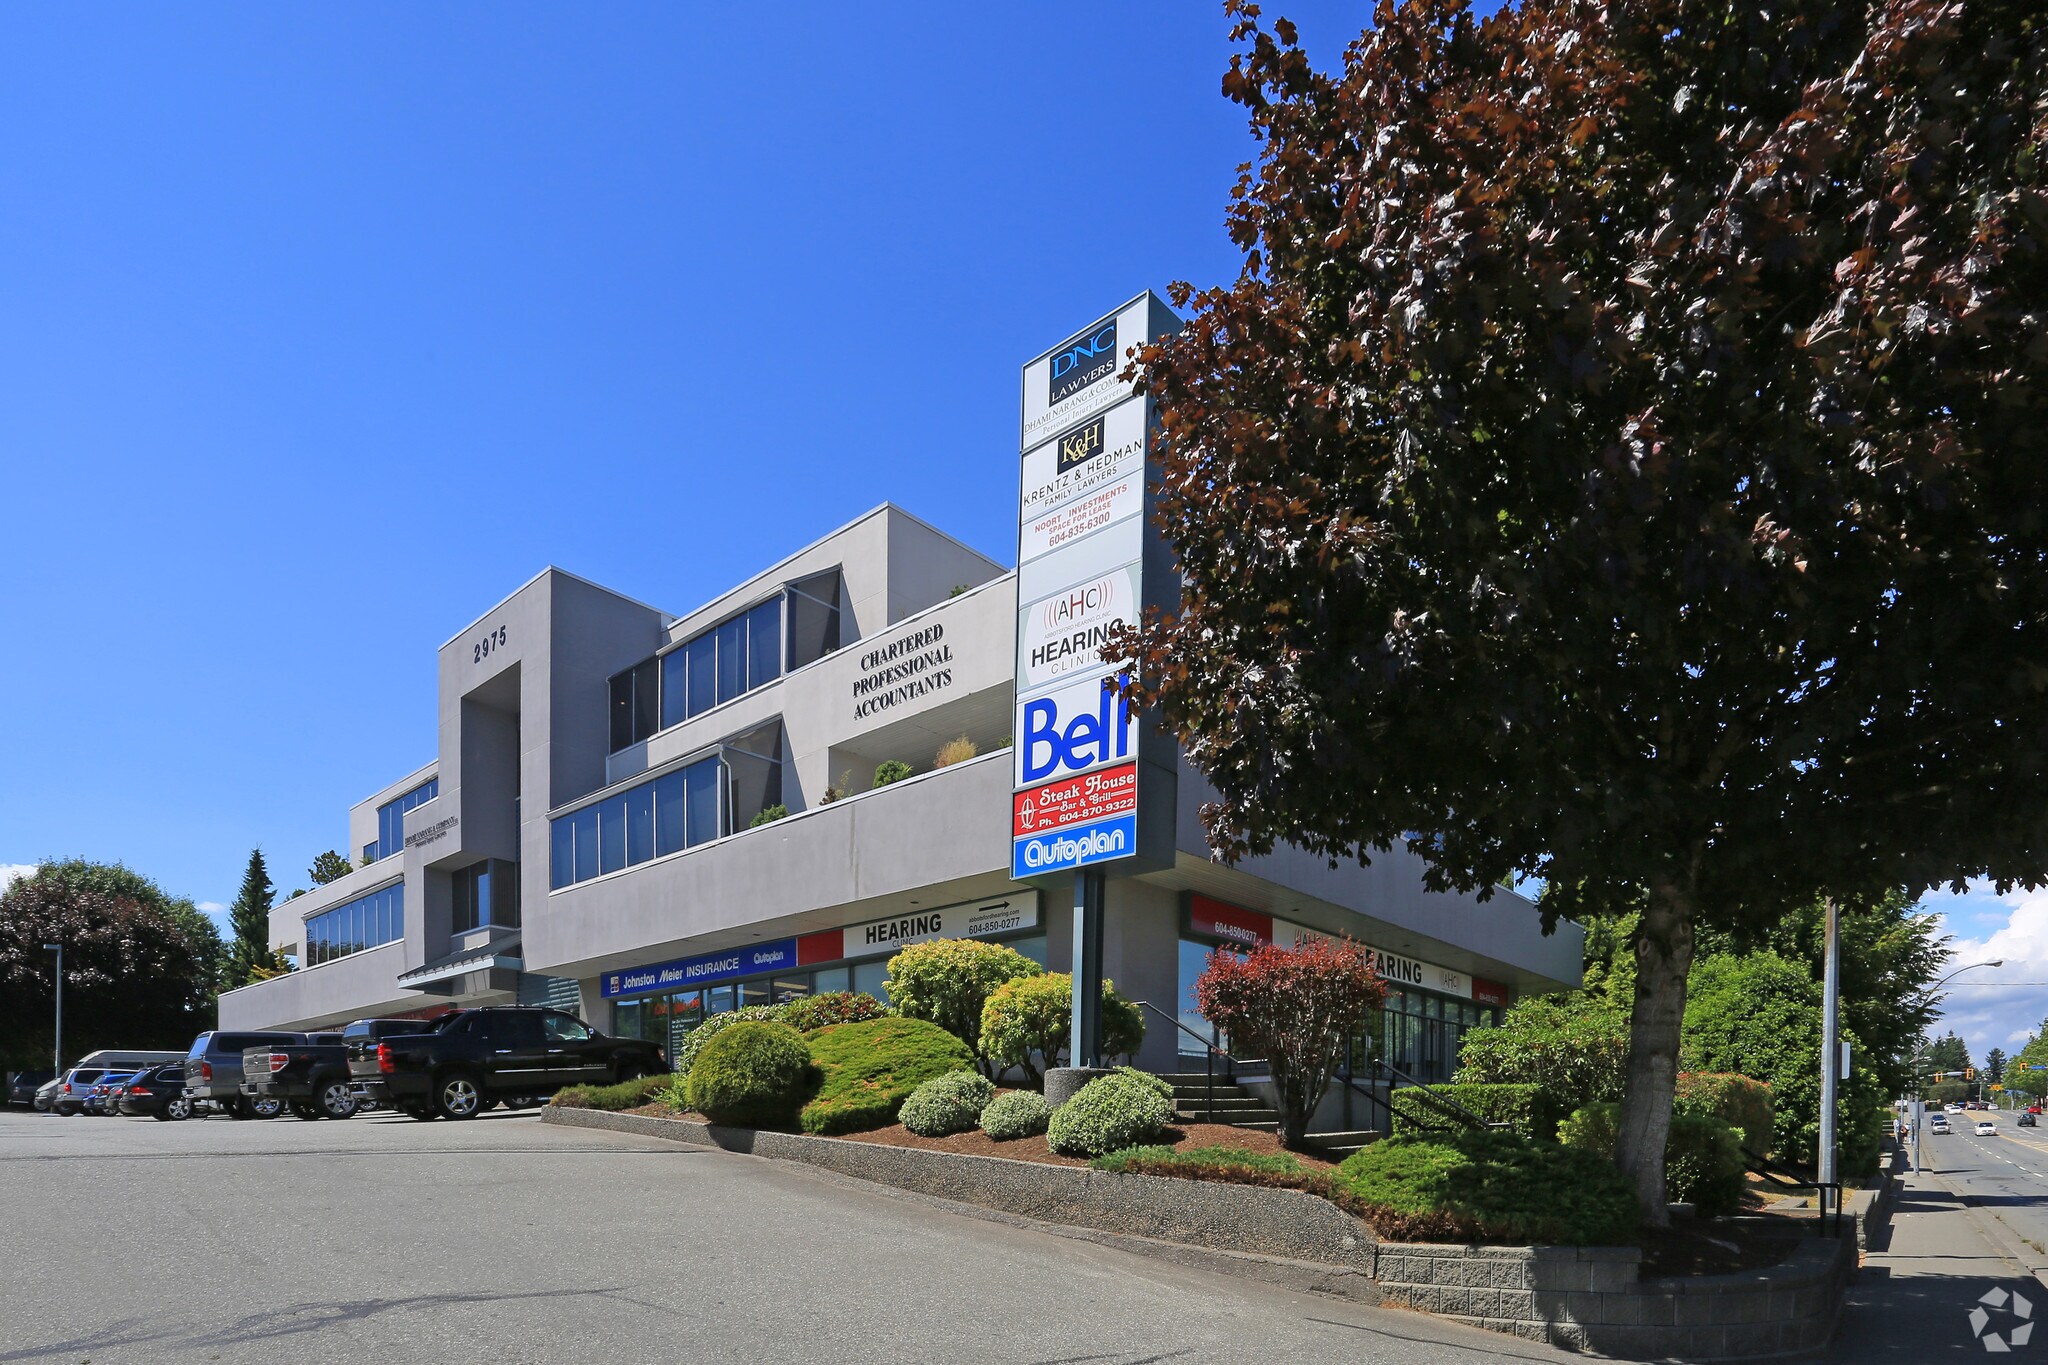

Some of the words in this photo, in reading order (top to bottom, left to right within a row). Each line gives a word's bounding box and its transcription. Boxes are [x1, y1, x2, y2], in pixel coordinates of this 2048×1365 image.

[1052, 325, 1115, 380] DNC
[1051, 359, 1113, 402] LAWYERS
[1024, 412, 1051, 433] DHAMI
[1052, 392, 1088, 418] NARANG
[1088, 390, 1095, 399] &
[1042, 412, 1070, 435] Personal
[1072, 405, 1093, 421] Injury
[1095, 388, 1123, 407] Lawyers
[1062, 423, 1100, 464] K&H
[1024, 475, 1069, 506] KRENTZ
[1074, 469, 1082, 481] &
[1087, 439, 1142, 475] HEDMAN
[1044, 487, 1072, 508] FAMILY
[1077, 466, 1117, 492] LAWYERS
[1034, 515, 1062, 533] NOORT
[1068, 484, 1128, 517] INVESTMENTS
[1049, 519, 1071, 534] SPACE
[1073, 513, 1087, 524] FOR
[1089, 501, 1112, 518] LEASE
[1049, 511, 1110, 547] 604-835-6300
[1058, 588, 1097, 621] AHC
[1044, 625, 1074, 639] ABBOTSFORD
[1074, 618, 1096, 630] HEARING
[1096, 610, 1112, 621] CLINIC
[474, 624, 507, 664] 2975
[861, 623, 944, 672] CHARTERED
[852, 643, 953, 698] PROFESSIONAL
[1051, 651, 1101, 675] CLINIC
[853, 668, 952, 720] ACCOUNTANTS
[1022, 673, 1129, 784] Bell
[1039, 784, 1080, 807] Steak
[1085, 772, 1135, 796] House
[1060, 801, 1077, 812] Bar
[1079, 798, 1086, 807] &
[1089, 792, 1111, 805] Grill
[1039, 818, 1054, 828] Ph.
[1059, 797, 1134, 824] 604-870-9322
[866, 914, 942, 944] HEARING
[968, 908, 1020, 923] abbotsfordhearing.com
[968, 917, 1020, 935] 604-850-0277
[1214, 921, 1257, 941] 604-850-0277
[892, 937, 914, 948] CLINIC
[623, 973, 655, 989] Johnston
[659, 969, 683, 983] Meier
[686, 957, 739, 978] INSURANCE
[1355, 949, 1422, 984] ARING
